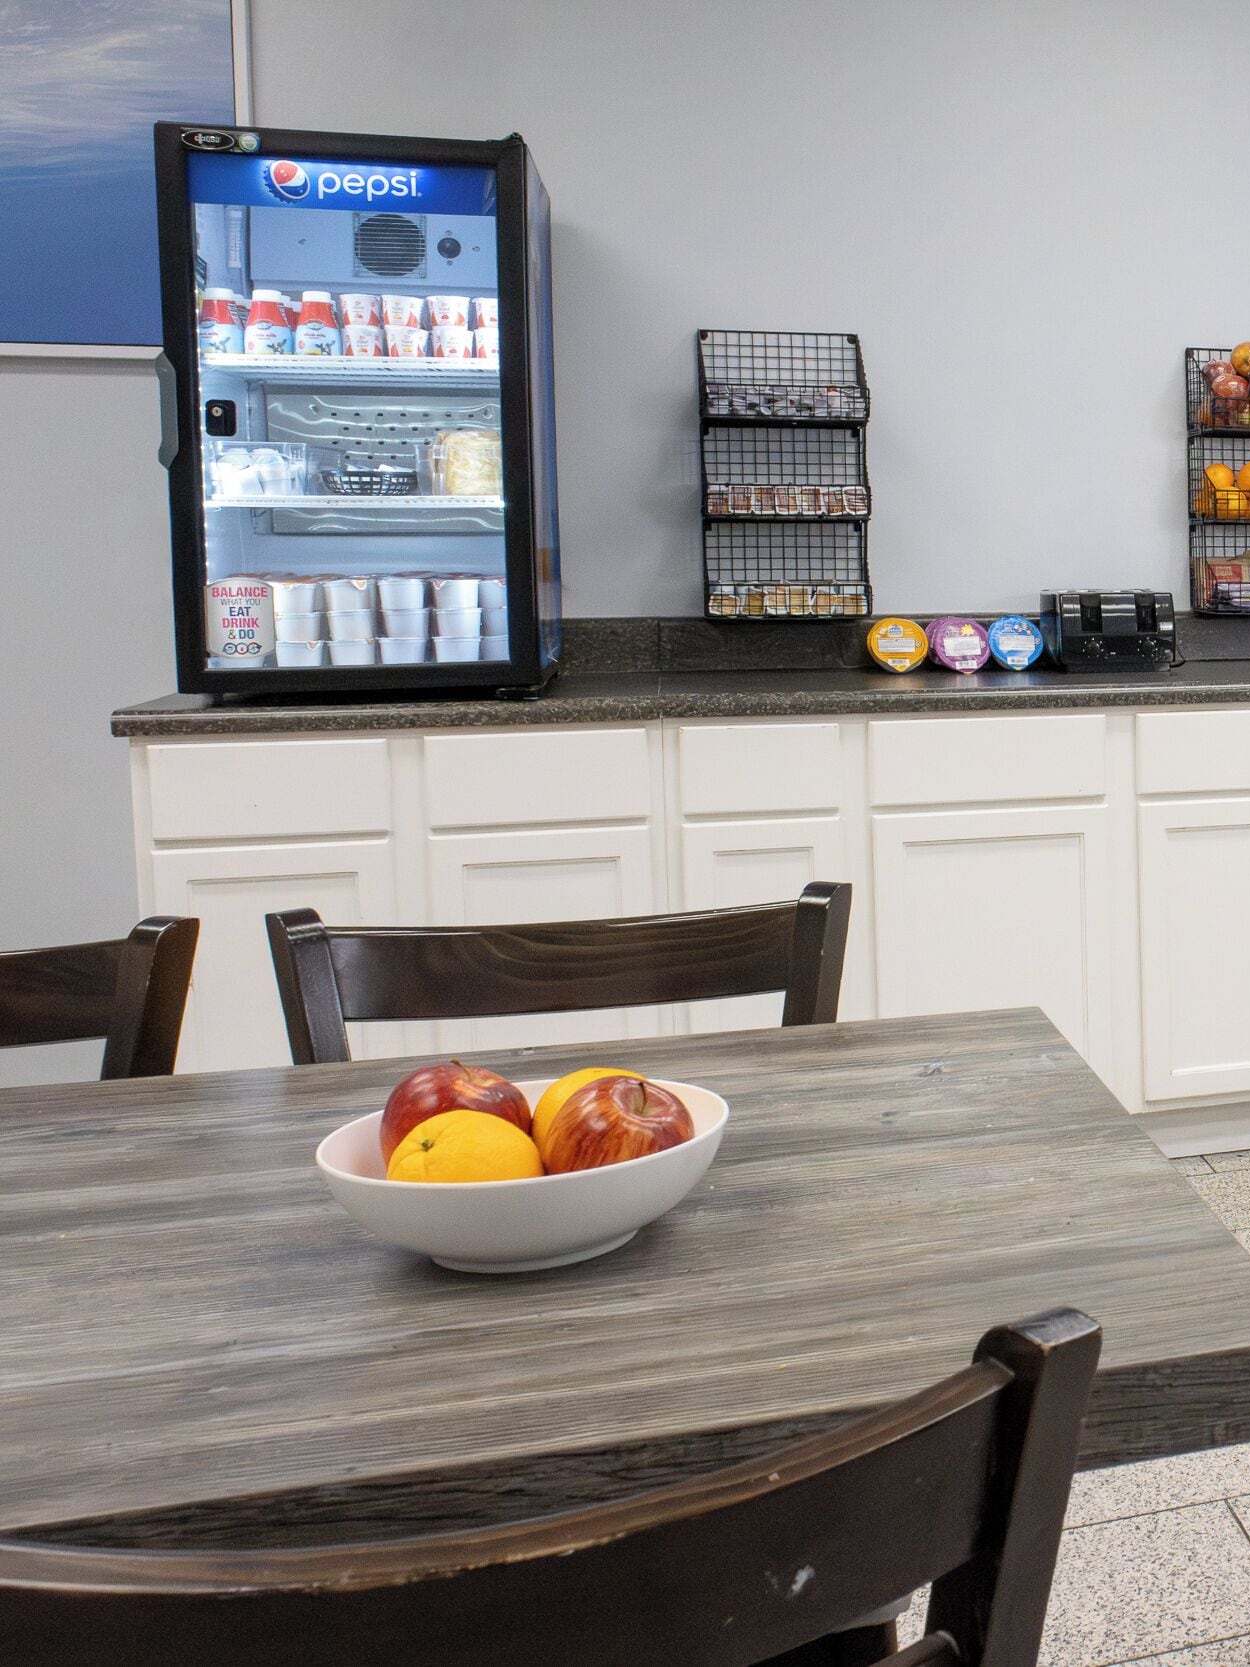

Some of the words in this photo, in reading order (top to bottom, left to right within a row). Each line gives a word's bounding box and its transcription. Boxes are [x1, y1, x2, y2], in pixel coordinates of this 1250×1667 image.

[318, 171, 418, 201] pepsi
[211, 587, 268, 598] BALANCE
[222, 618, 260, 628] DRINK
[228, 629, 236, 640] &
[238, 629, 255, 640] DO
